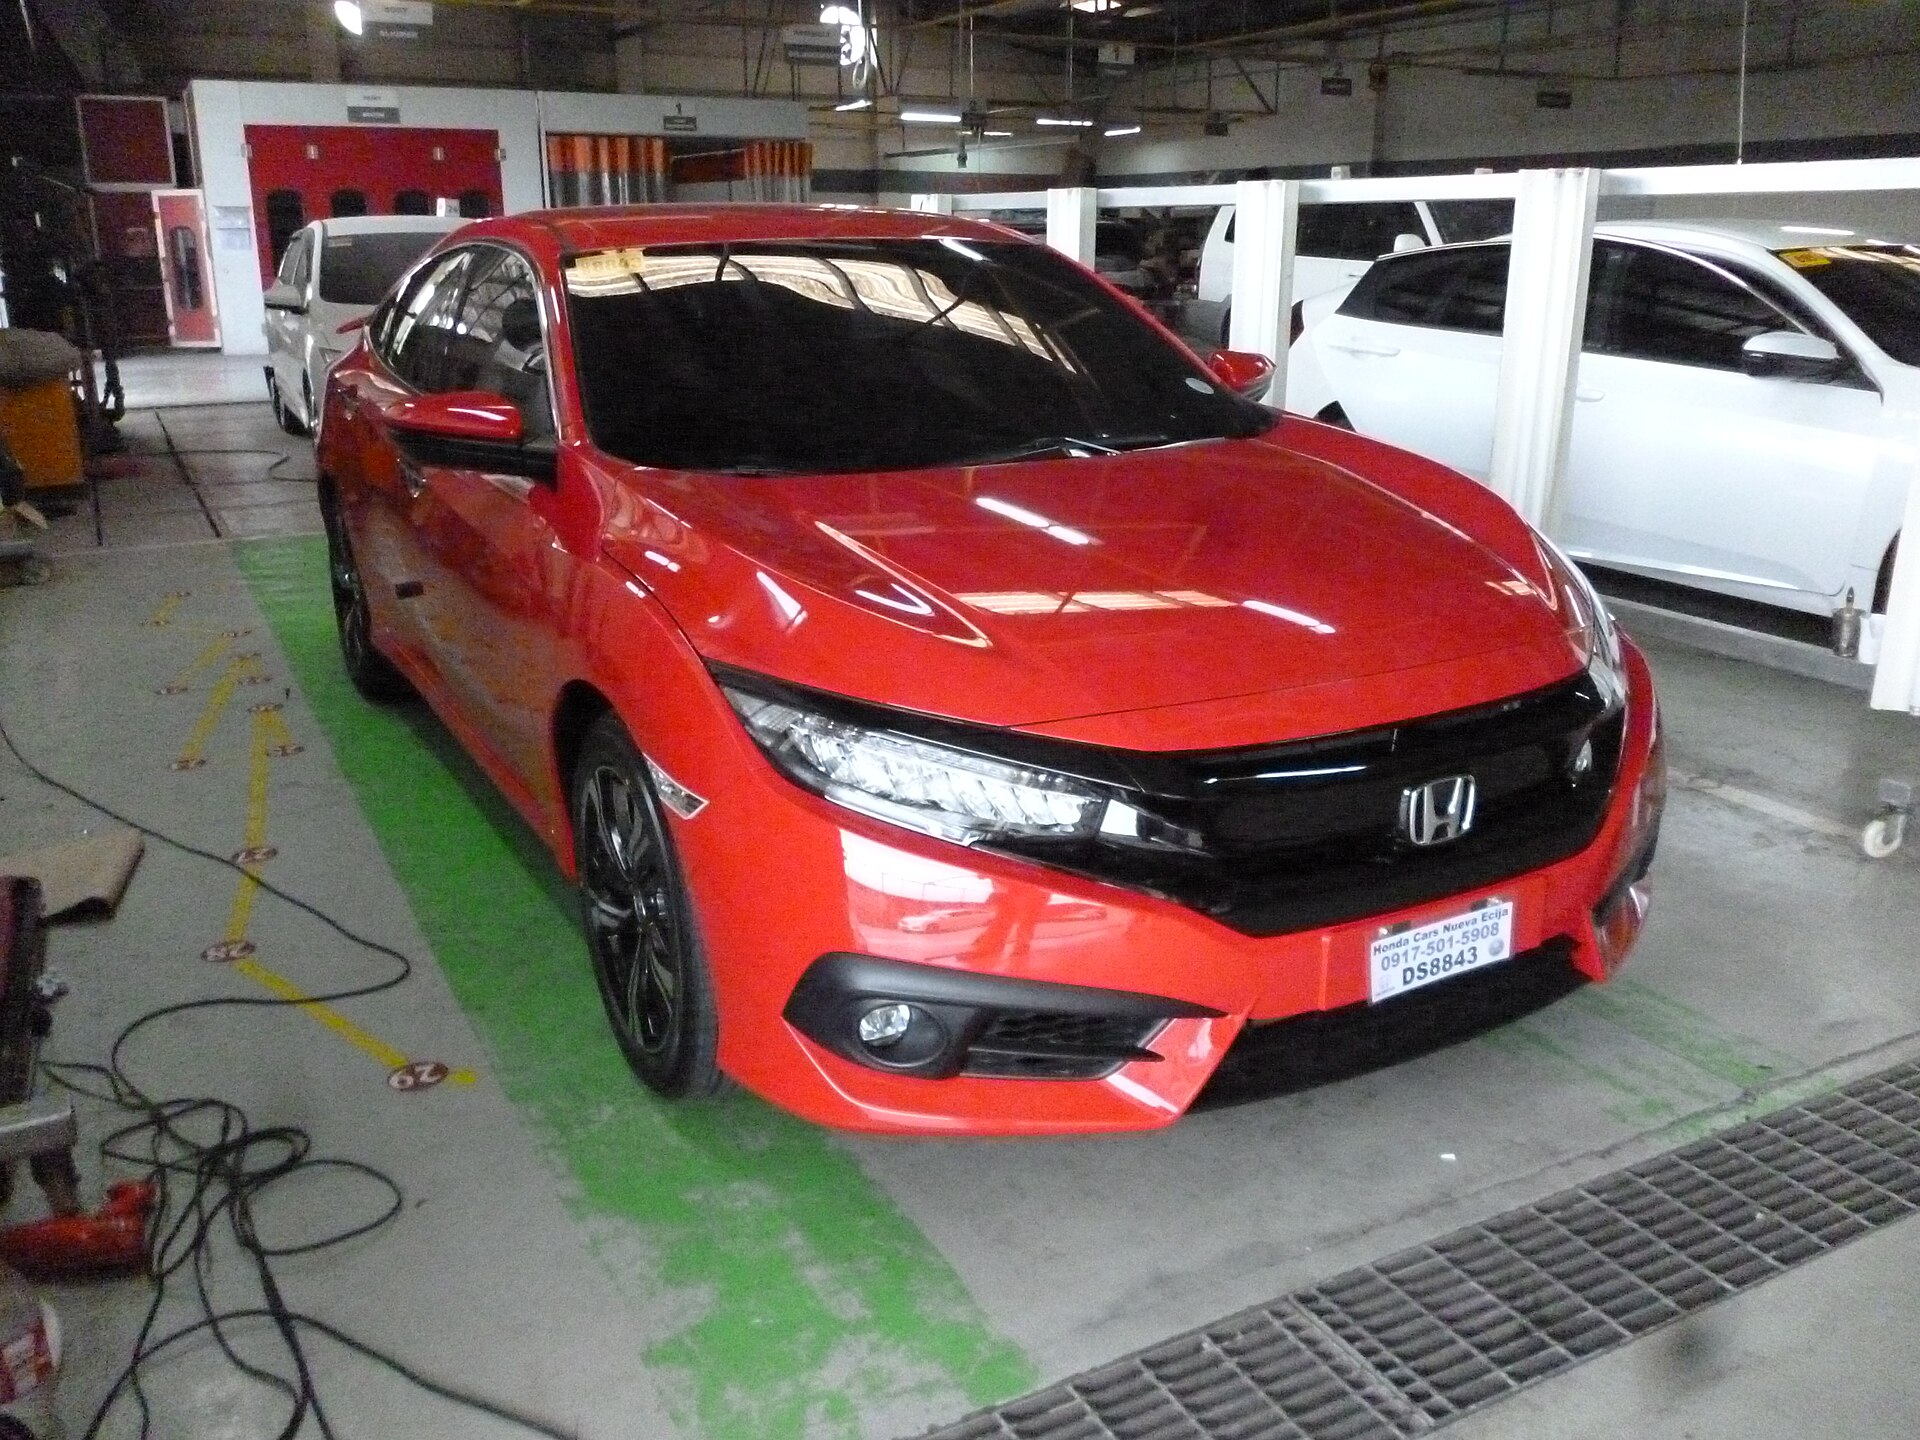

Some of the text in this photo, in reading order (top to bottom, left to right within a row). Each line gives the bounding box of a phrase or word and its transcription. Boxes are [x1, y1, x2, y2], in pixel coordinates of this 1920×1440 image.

[1373, 907, 1509, 956] Honda Cars Nueva Ecija
[1381, 922, 1500, 972] 0917-501-5908
[1402, 946, 1478, 986] DS8843
